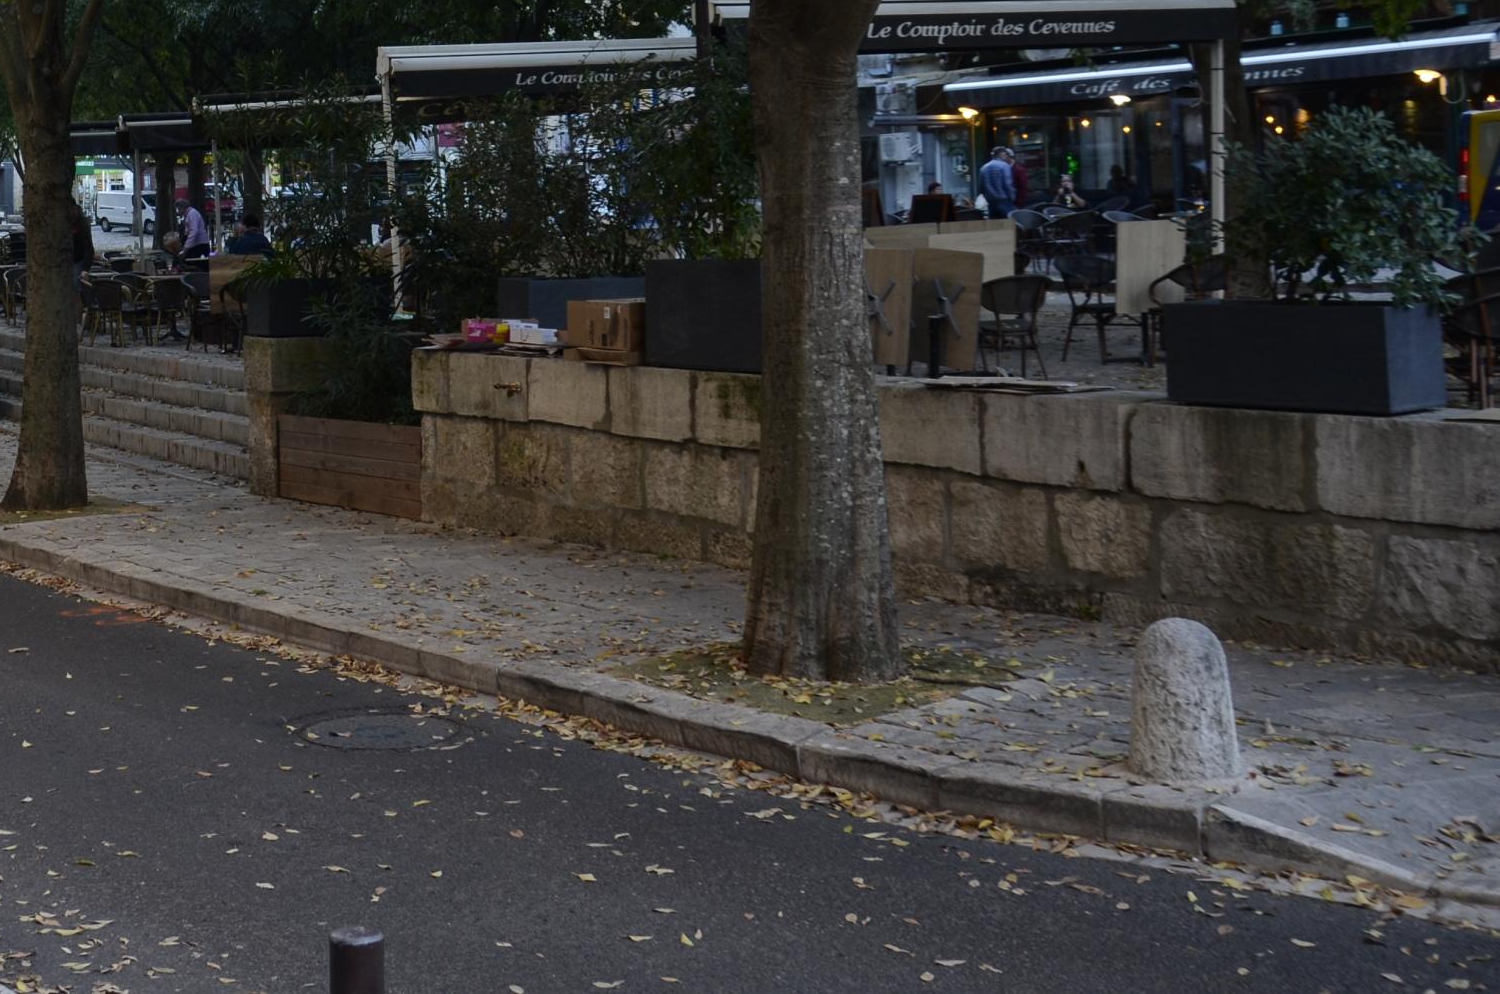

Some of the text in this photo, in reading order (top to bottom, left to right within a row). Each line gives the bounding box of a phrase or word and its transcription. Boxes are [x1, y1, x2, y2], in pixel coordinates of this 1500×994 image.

[867, 18, 1117, 45] Le Comptoir des Cevennes
[515, 72, 537, 86] Le
[1070, 79, 1121, 99] Café
[1133, 76, 1173, 91] des
